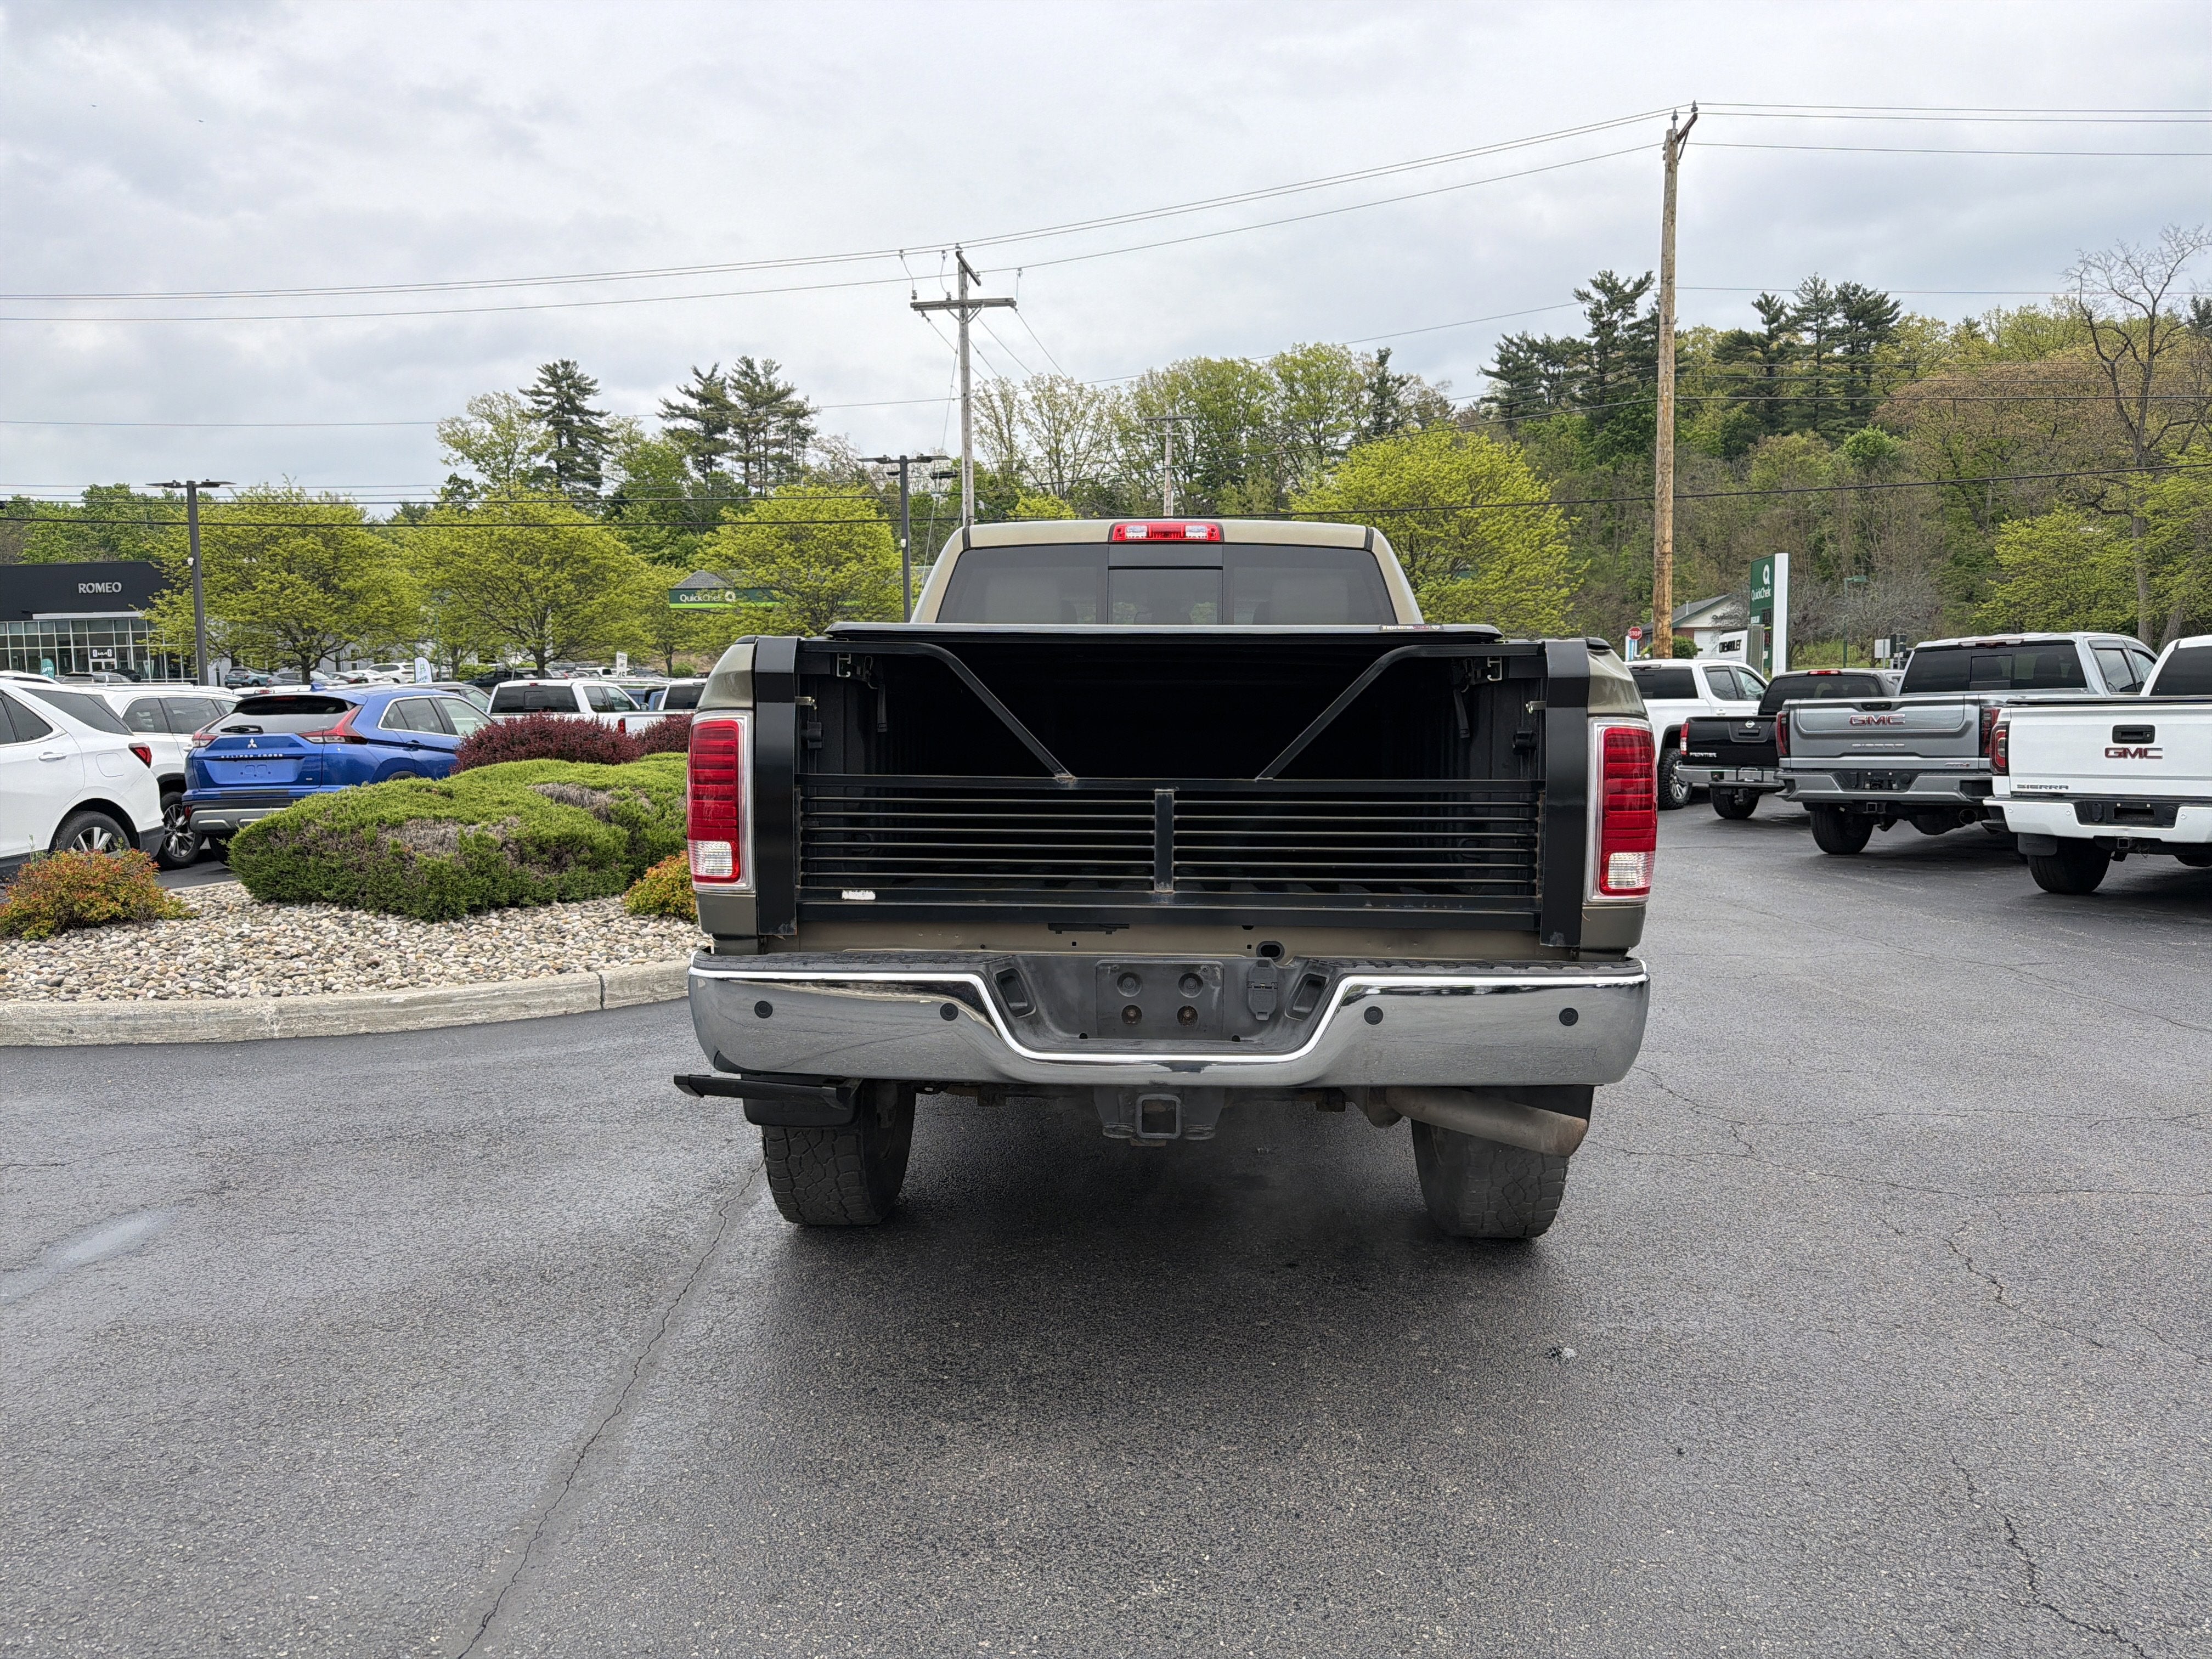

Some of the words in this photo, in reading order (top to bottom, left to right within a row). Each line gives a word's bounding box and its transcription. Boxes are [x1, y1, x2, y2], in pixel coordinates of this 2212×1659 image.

[78, 582, 122, 594] ROMEO
[1751, 585, 1771, 602] QuickChek
[1849, 713, 1906, 726] GMC
[2104, 747, 2163, 760] GMC
